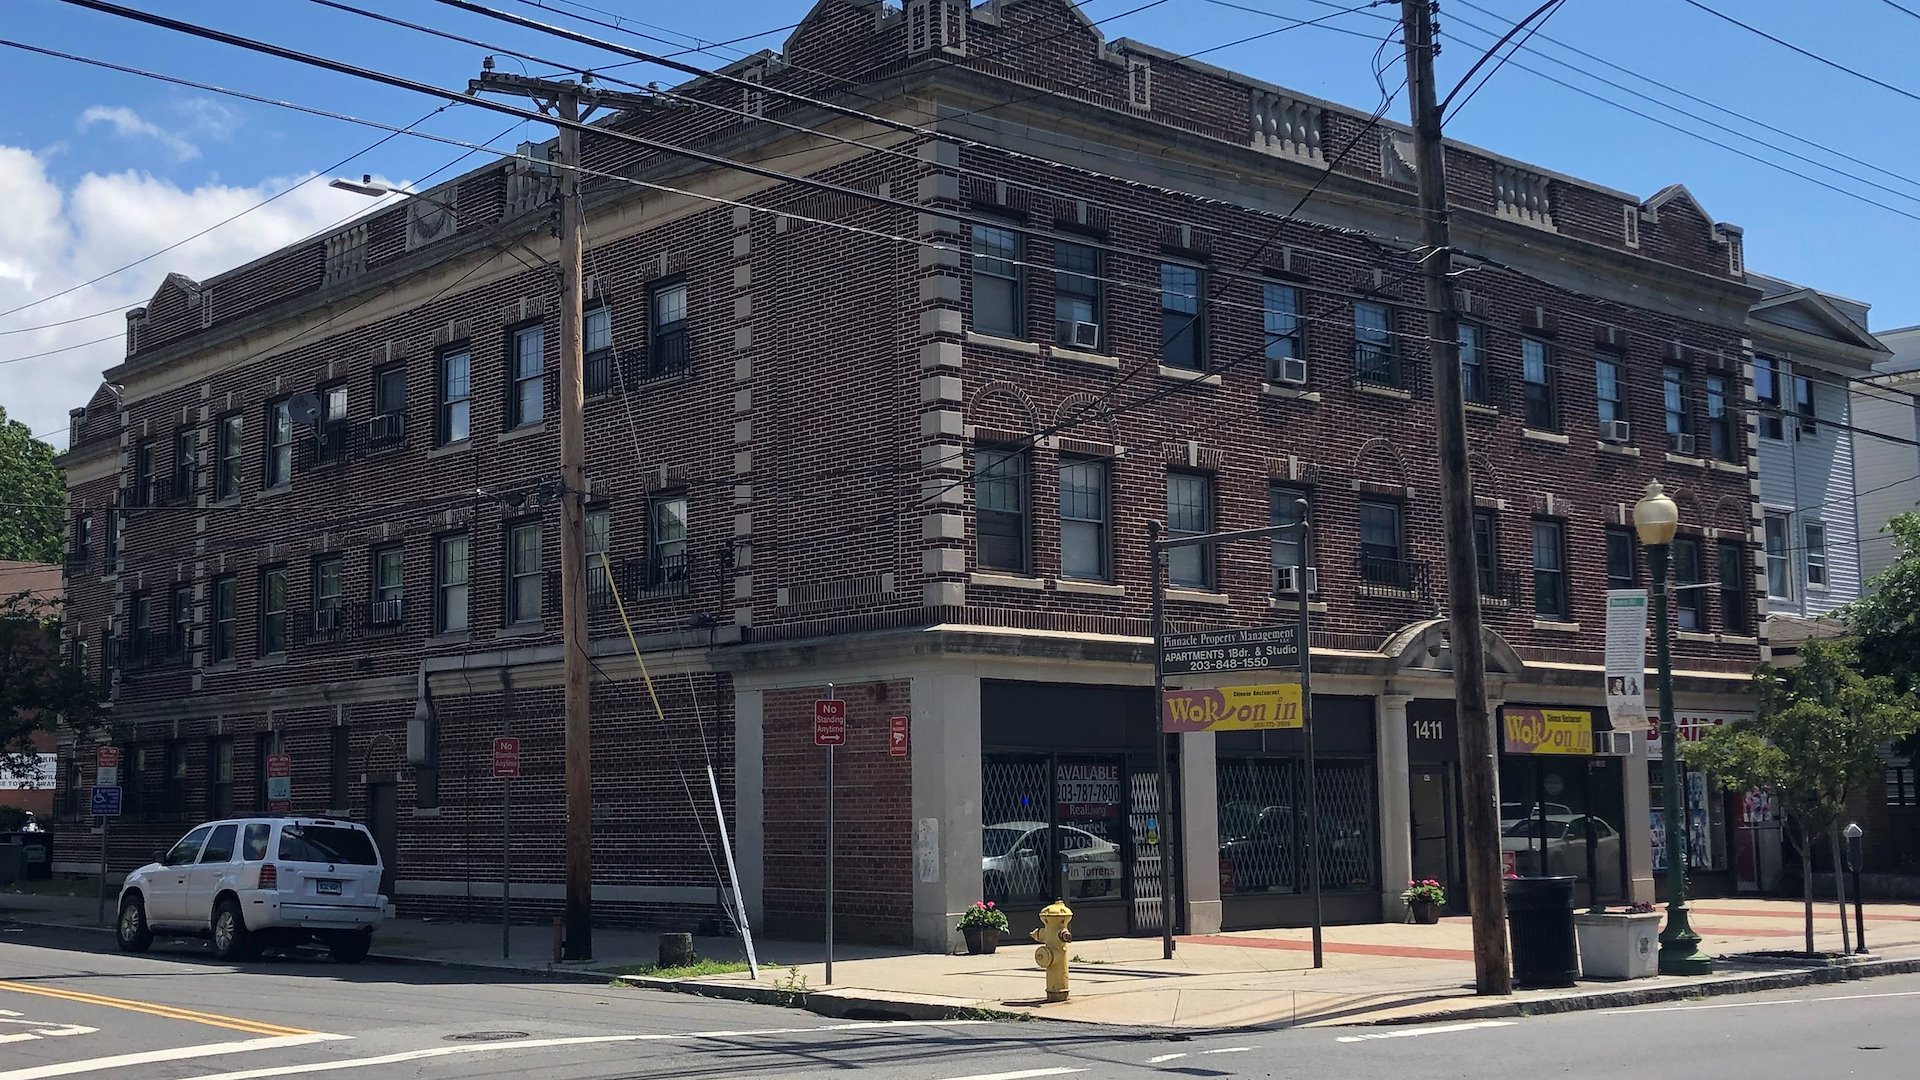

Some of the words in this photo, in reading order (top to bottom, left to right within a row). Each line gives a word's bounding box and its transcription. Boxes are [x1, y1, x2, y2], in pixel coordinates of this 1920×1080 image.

[1163, 634, 1198, 648] Pinnacle
[1200, 632, 1236, 645] Property
[1239, 628, 1294, 643] Management
[1164, 649, 1224, 662] APARTMENTS
[1227, 648, 1251, 658] 1Bdr.
[1255, 646, 1261, 656] &
[1266, 644, 1297, 656] Studio
[1190, 657, 1269, 671] 203-848-1550
[823, 704, 837, 714] No
[1167, 696, 1219, 723] Wok
[1237, 703, 1267, 721] on
[1274, 697, 1297, 720] in
[816, 715, 844, 725] Standing
[816, 725, 844, 734] Anytime
[1412, 720, 1443, 740] 1411
[1504, 715, 1542, 744] Wok
[1554, 730, 1572, 747] on
[500, 742, 513, 751] No
[1057, 765, 1118, 780] AVAILABLE
[1081, 866, 1115, 877] Torrens
